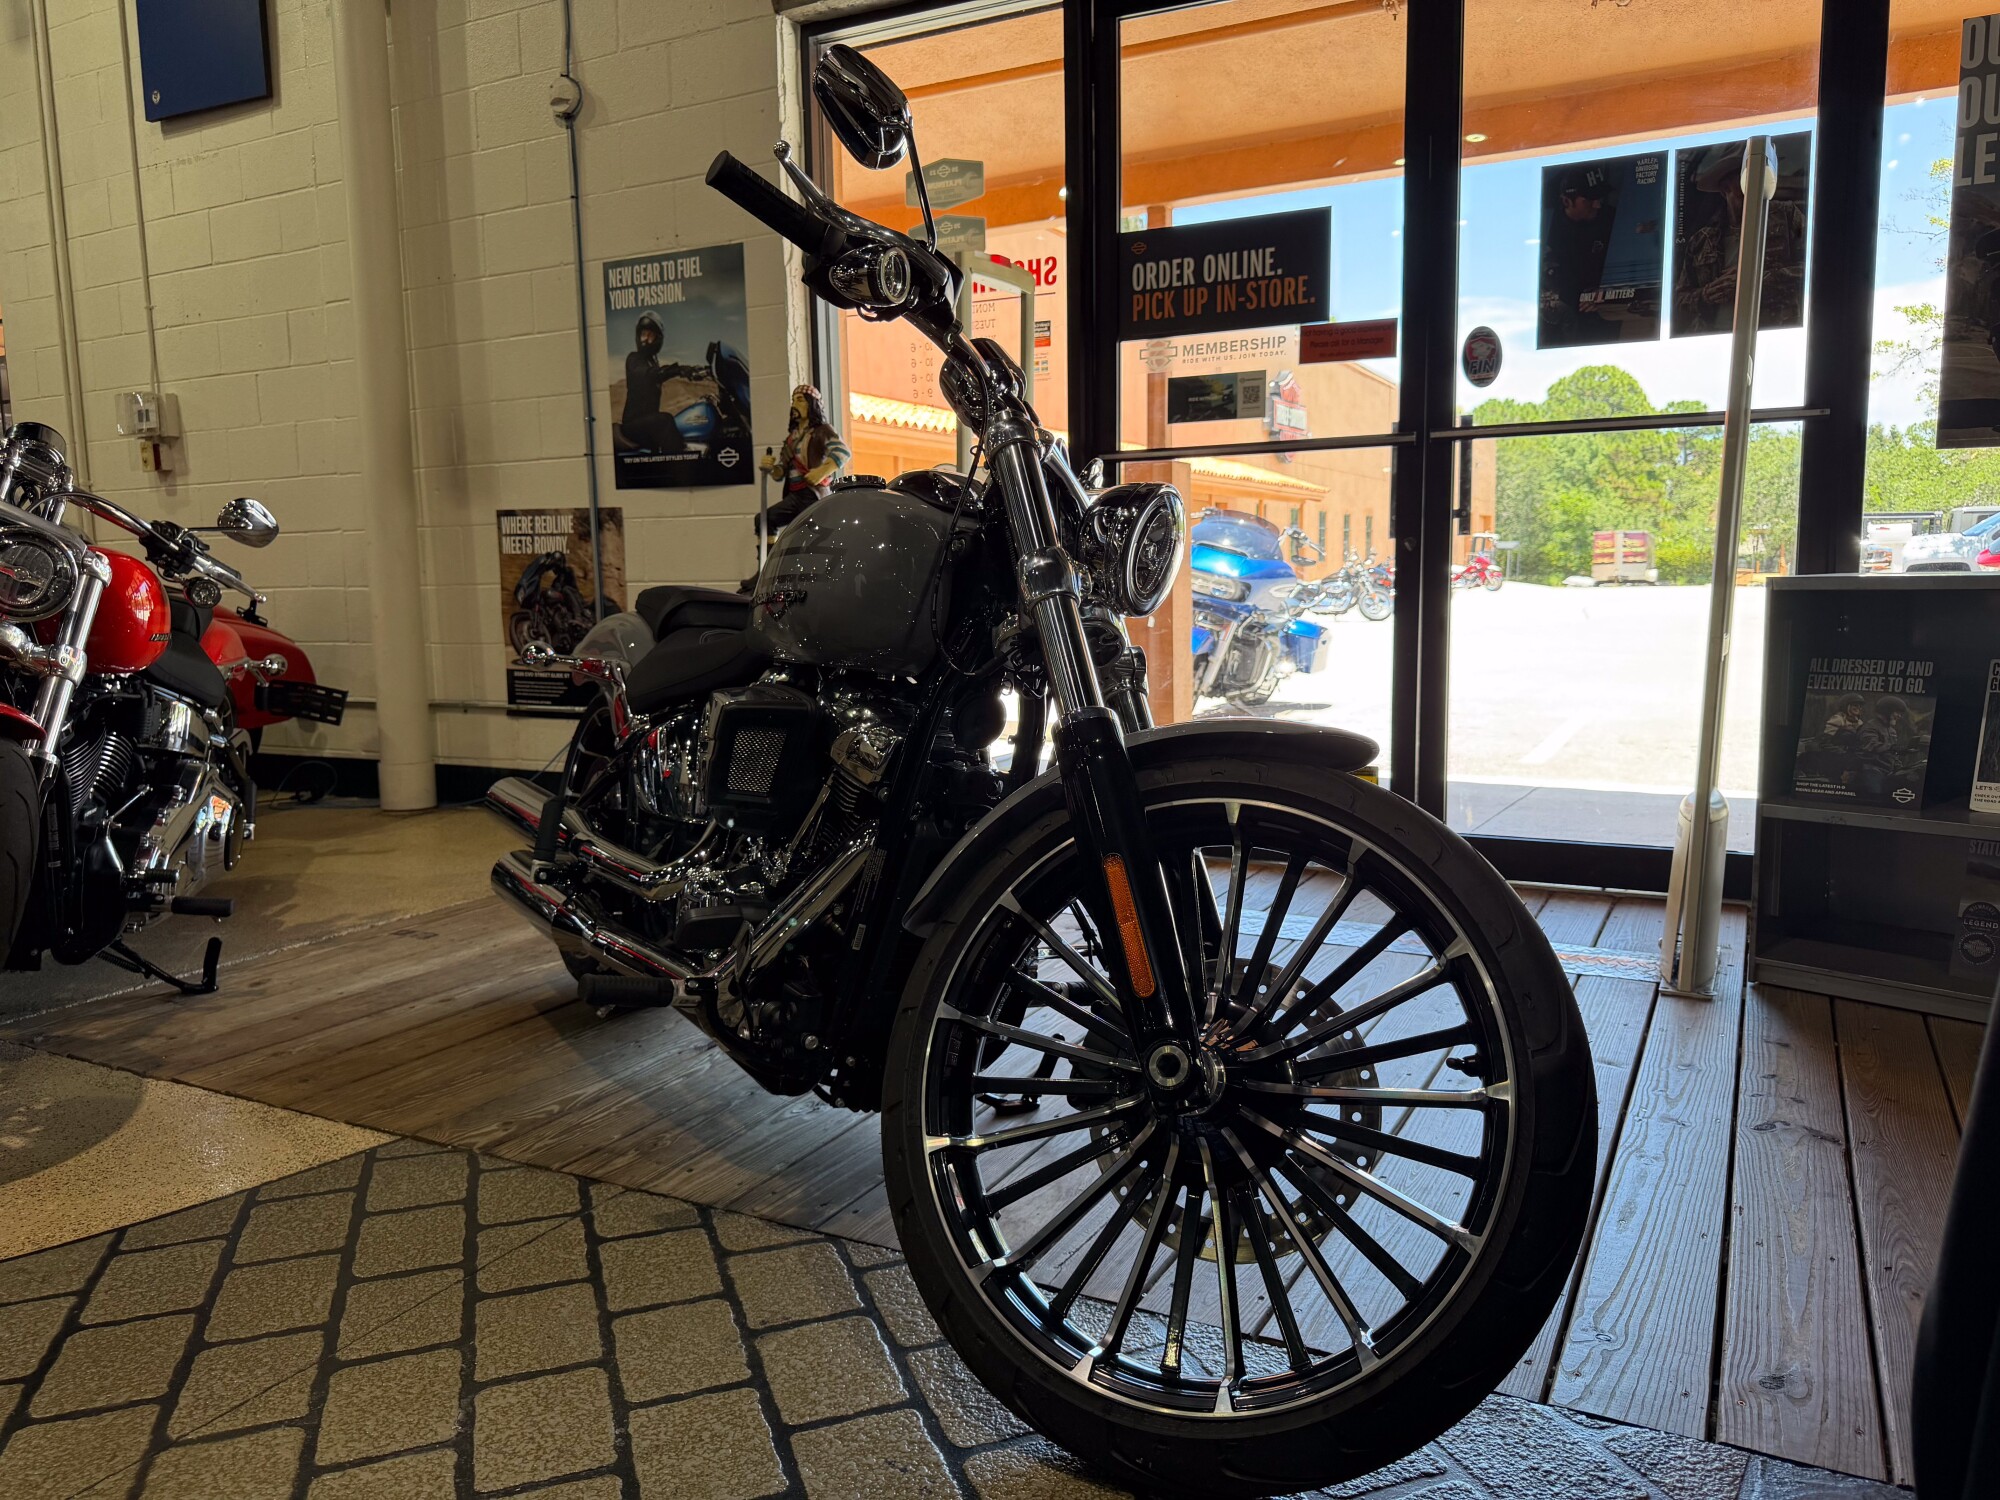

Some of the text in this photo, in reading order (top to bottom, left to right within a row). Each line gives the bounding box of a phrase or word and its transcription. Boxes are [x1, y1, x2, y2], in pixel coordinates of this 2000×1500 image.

[1635, 164, 1659, 172] DAVIDSON
[608, 256, 703, 288] NEW GEAR TO FUEL
[1132, 247, 1283, 292] ORDER ONLINE.
[609, 281, 686, 311] YOUR PASSION.
[1132, 275, 1316, 322] PICK UP IN-STORE.
[1579, 292, 1596, 302] ONLY
[1605, 289, 1636, 300] MATTERS
[1182, 336, 1287, 357] MEMBERSHIP
[1202, 355, 1221, 363] WITH
[1238, 352, 1256, 360] JOIN
[1259, 350, 1287, 358] TODAY.
[500, 514, 574, 535] WHERE REDLINE
[502, 535, 570, 554] MEETS ROWDY.
[1809, 658, 1934, 677] ALL DRESSED UP AND
[1807, 673, 1926, 694] EVERYWHERE TO GO.
[1963, 918, 1999, 929] LEGEND
